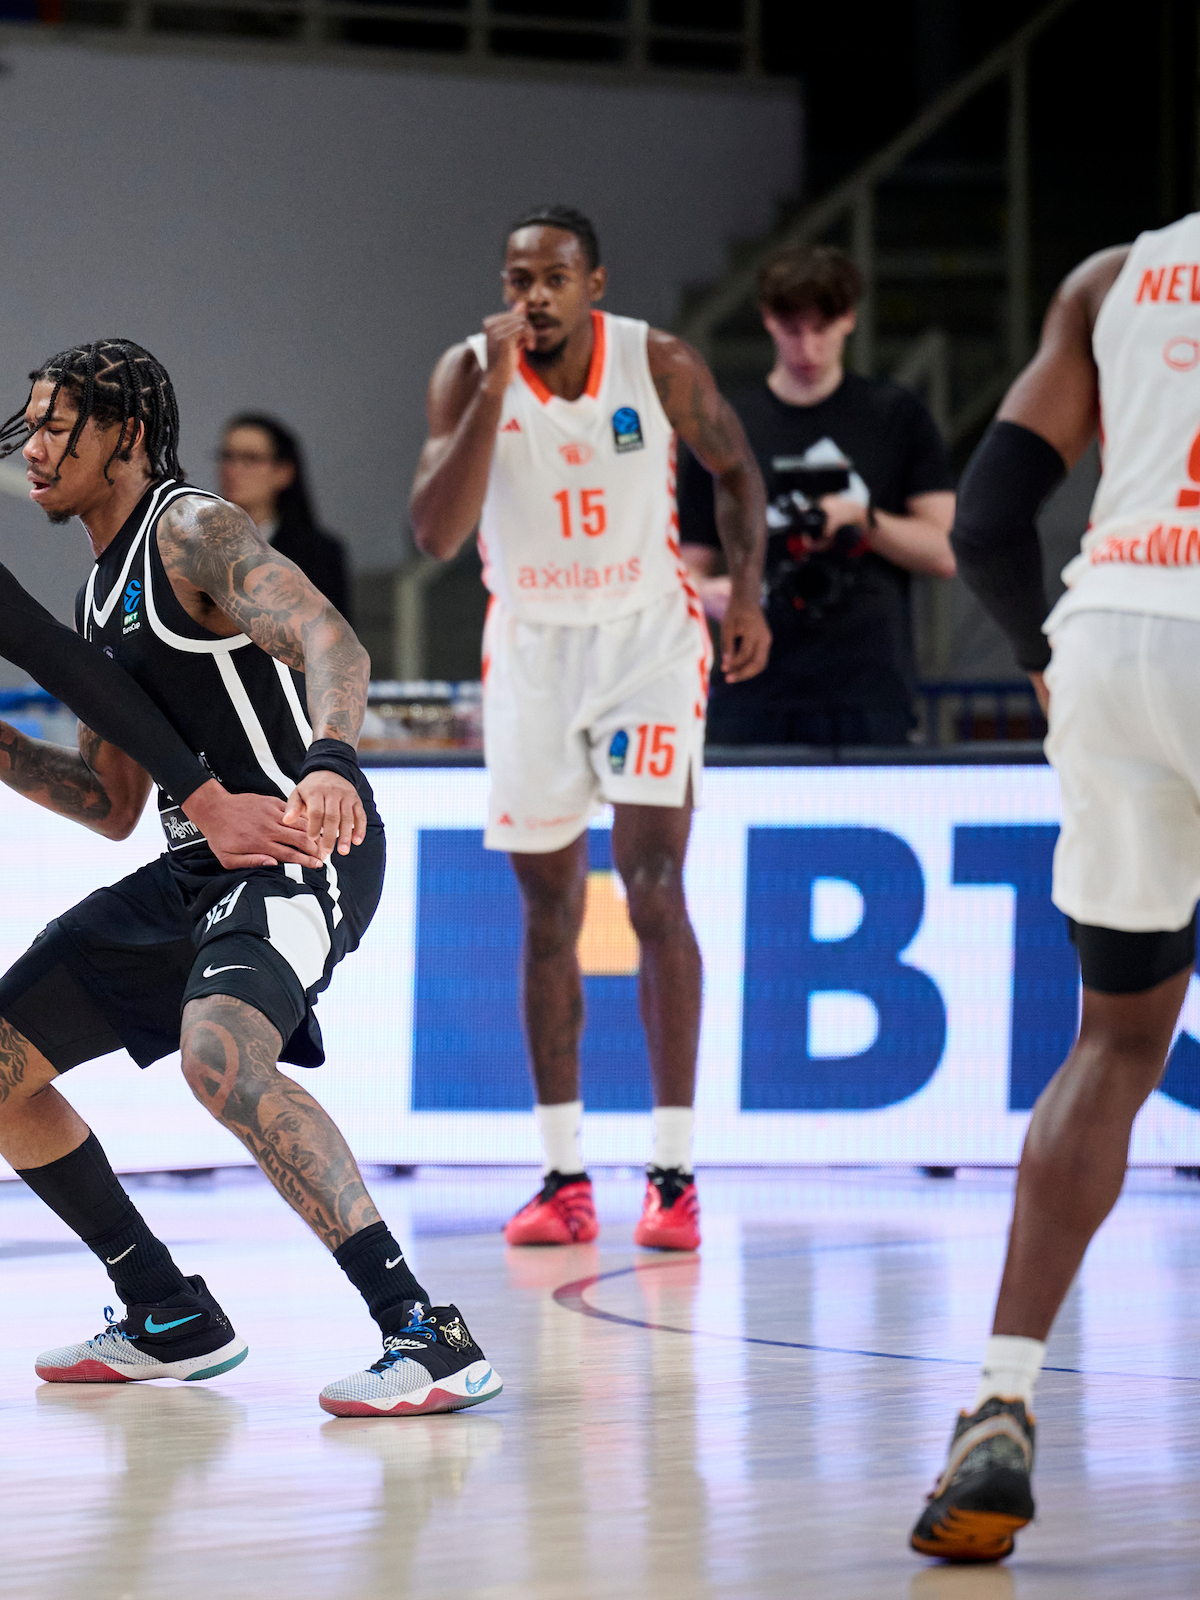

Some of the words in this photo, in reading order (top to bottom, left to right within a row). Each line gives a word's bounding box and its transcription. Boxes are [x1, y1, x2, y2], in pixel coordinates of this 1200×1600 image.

[1135, 265, 1200, 304] NE
[554, 488, 607, 539] 15
[517, 557, 642, 590] axilaris
[122, 622, 141, 635] EuroCup
[634, 724, 676, 779] 15
[738, 822, 1200, 1113] BT
